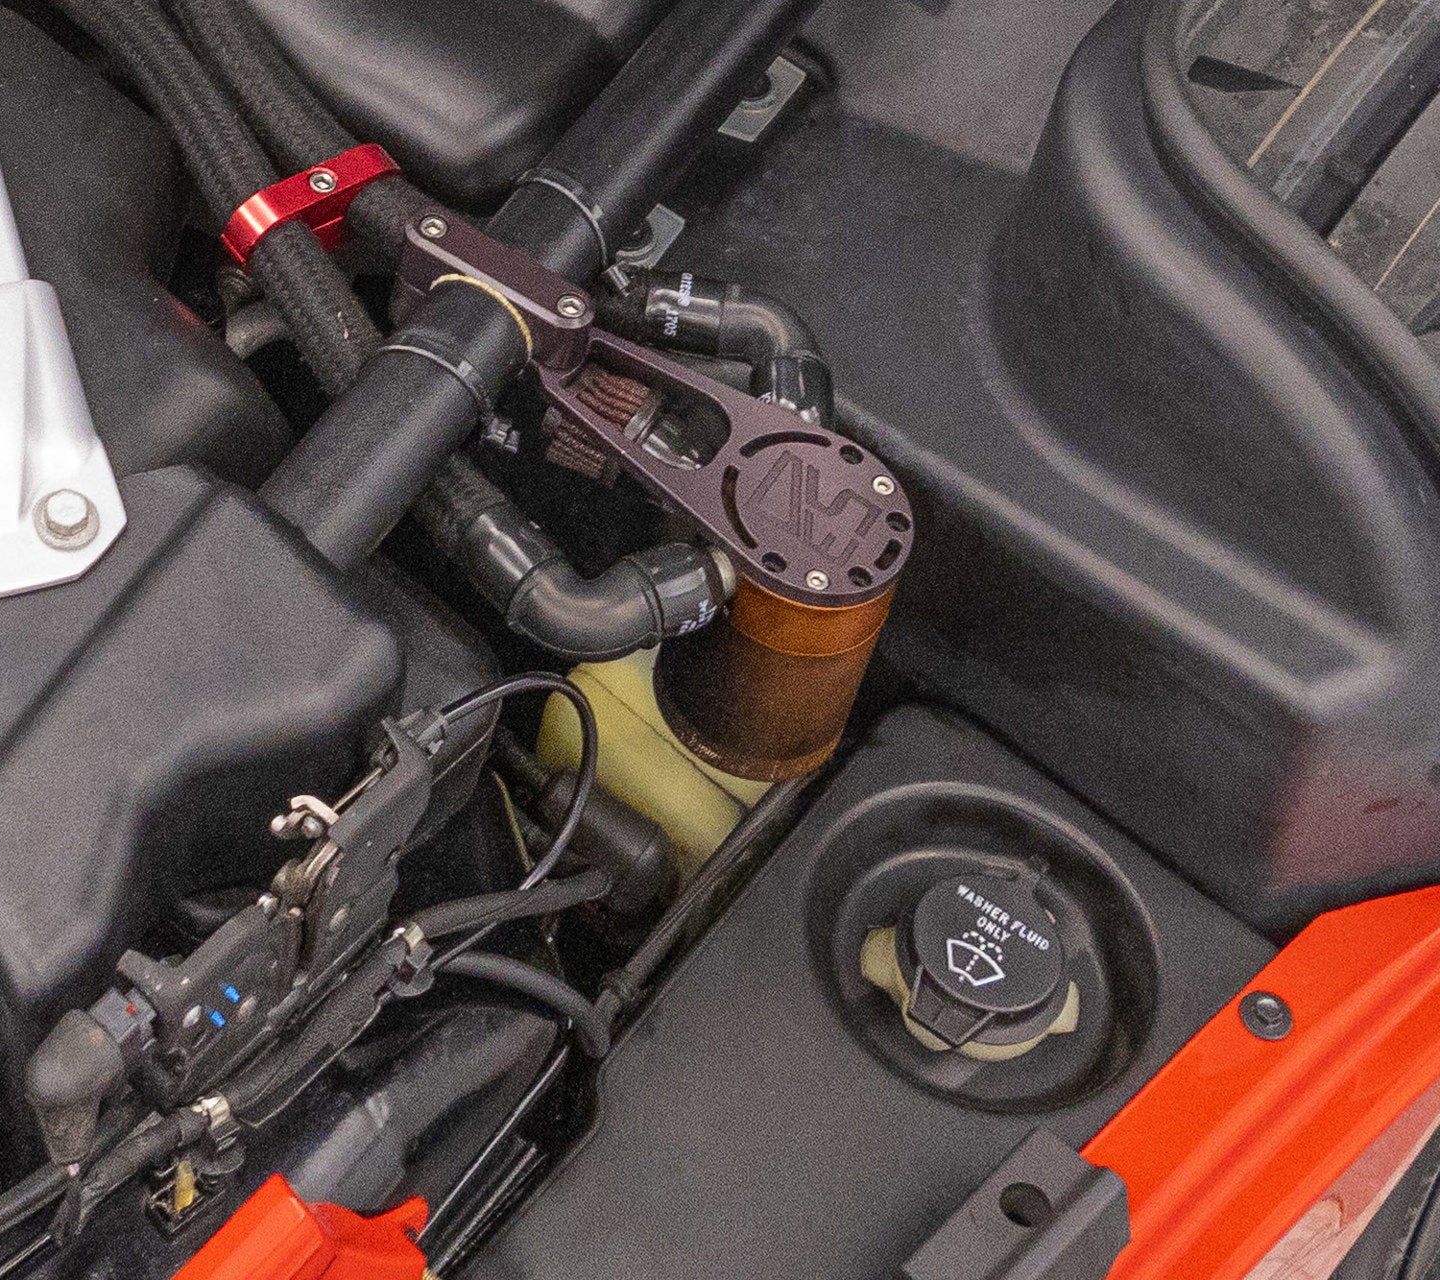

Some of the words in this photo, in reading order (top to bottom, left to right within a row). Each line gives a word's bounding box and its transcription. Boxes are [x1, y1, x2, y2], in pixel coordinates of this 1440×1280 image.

[957, 884, 1010, 926] WASHER
[1010, 920, 1050, 951] FLUID
[976, 915, 1012, 942] ONLY
